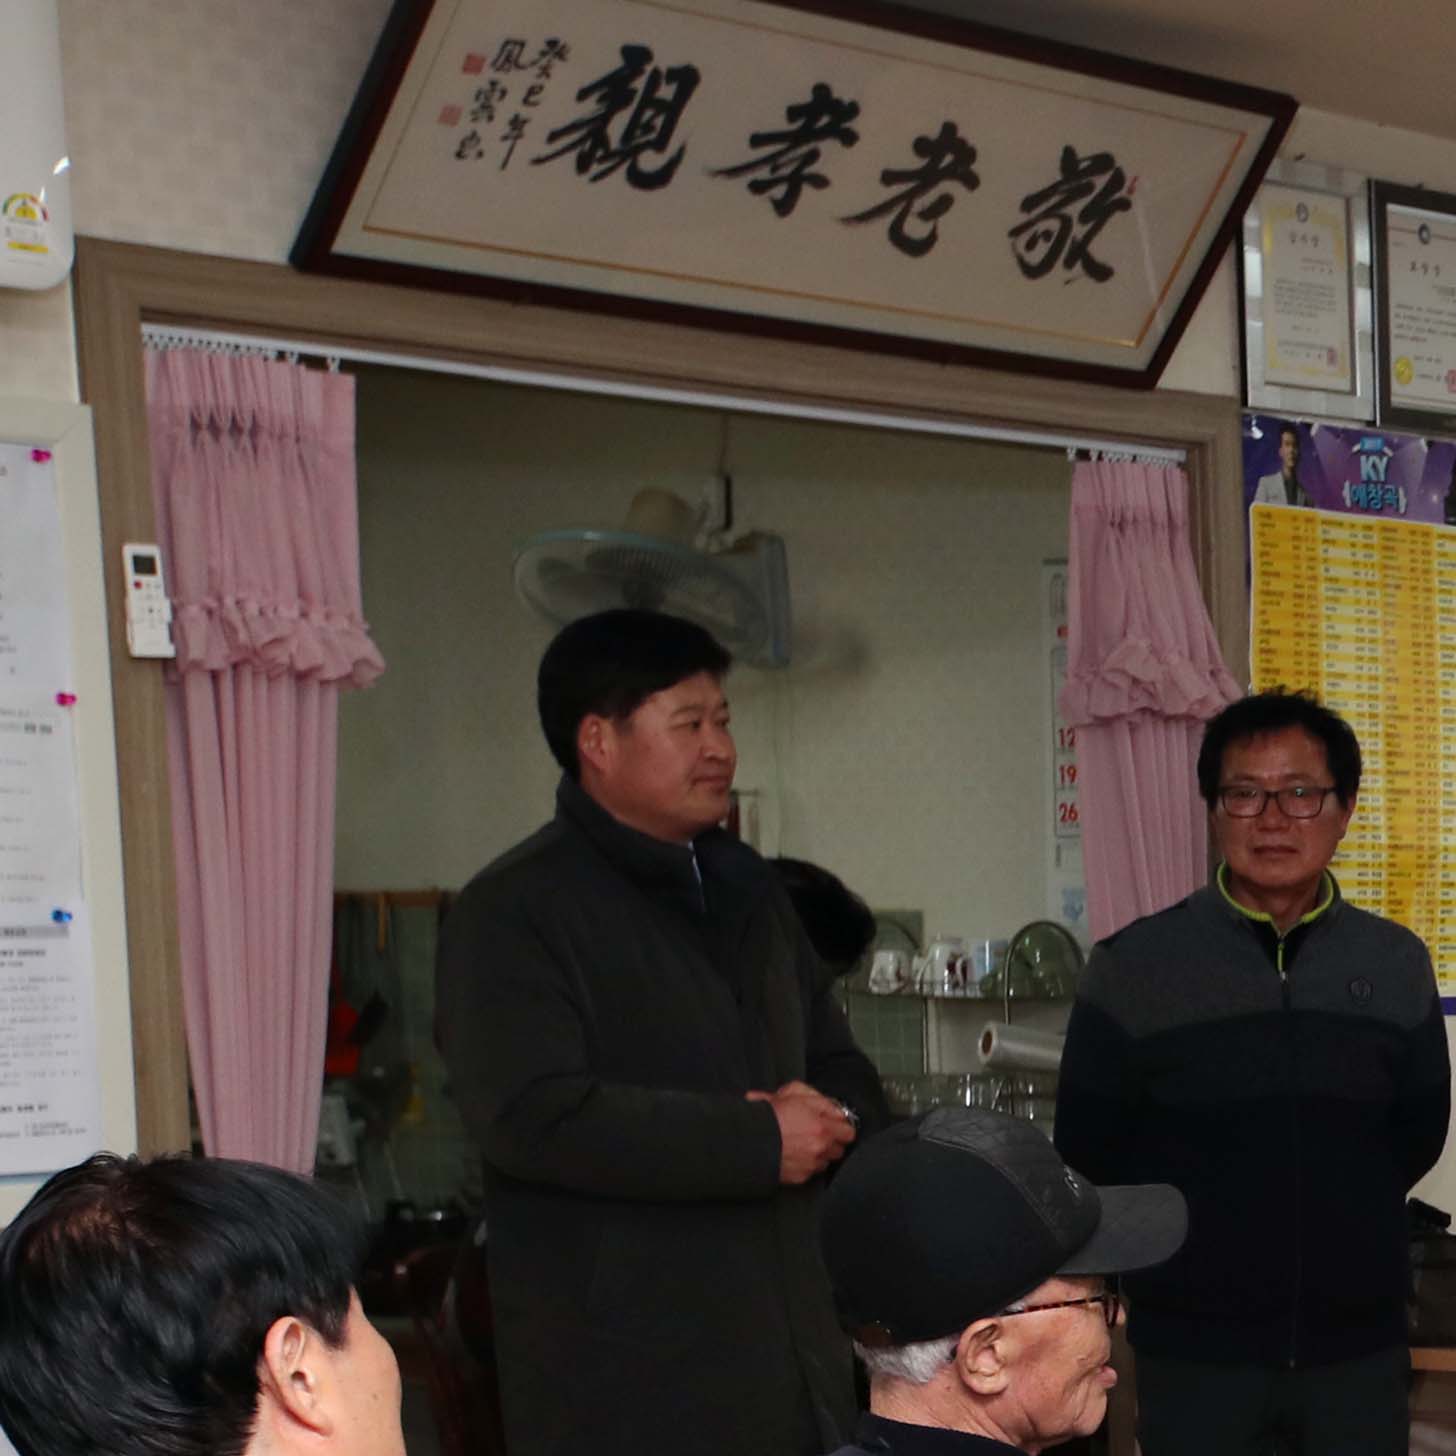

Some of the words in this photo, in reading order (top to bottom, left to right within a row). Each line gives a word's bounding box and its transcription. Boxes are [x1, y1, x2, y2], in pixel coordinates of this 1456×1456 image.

[1360, 455, 1388, 482] KY
[1059, 764, 1077, 785] 19
[1059, 802, 1079, 822] 26
